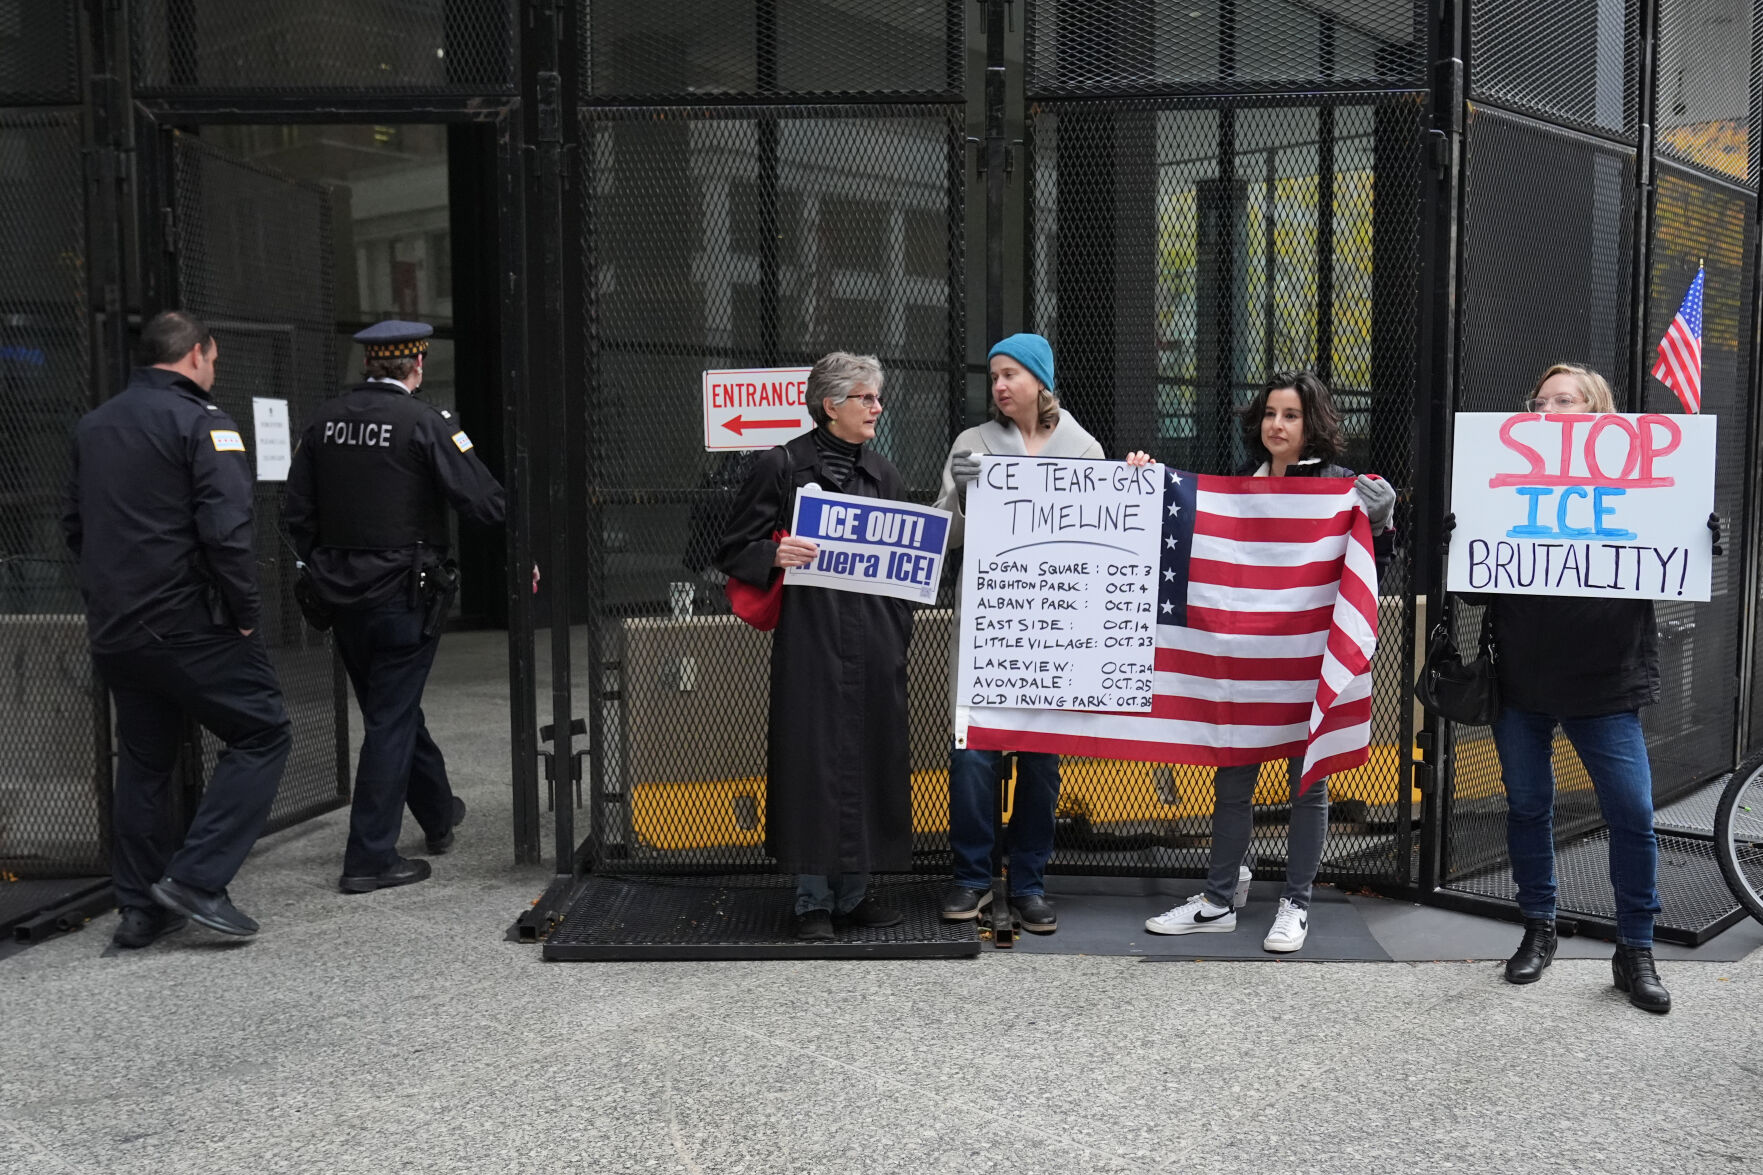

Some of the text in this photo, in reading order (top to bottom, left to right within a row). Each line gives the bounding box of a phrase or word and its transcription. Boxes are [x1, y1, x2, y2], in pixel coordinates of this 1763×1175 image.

[712, 382, 807, 408] ENTRANCE
[324, 421, 393, 447] POLICE
[1499, 413, 1682, 480] STOP
[1036, 462, 1156, 495] TEAR-GAS
[1003, 499, 1146, 535] TIMELINE
[1515, 485, 1630, 537] ICE
[818, 504, 925, 548] ICE OUT!
[795, 543, 935, 586] uera ICE!
[978, 558, 1028, 574] LOGAN
[1144, 565, 1152, 576] 3
[1468, 538, 1689, 596] BRUTALITY!
[977, 576, 1036, 590] BRIGHTON
[1139, 583, 1149, 594] 4
[977, 597, 1035, 610] ALBANY
[1137, 602, 1152, 613] 12
[974, 616, 1013, 631] EAST
[974, 635, 1024, 649] LITTLE
[1137, 636, 1153, 647] 23
[1135, 679, 1152, 692] 25
[971, 693, 1008, 705] OLD
[1015, 694, 1067, 708] IRVING
